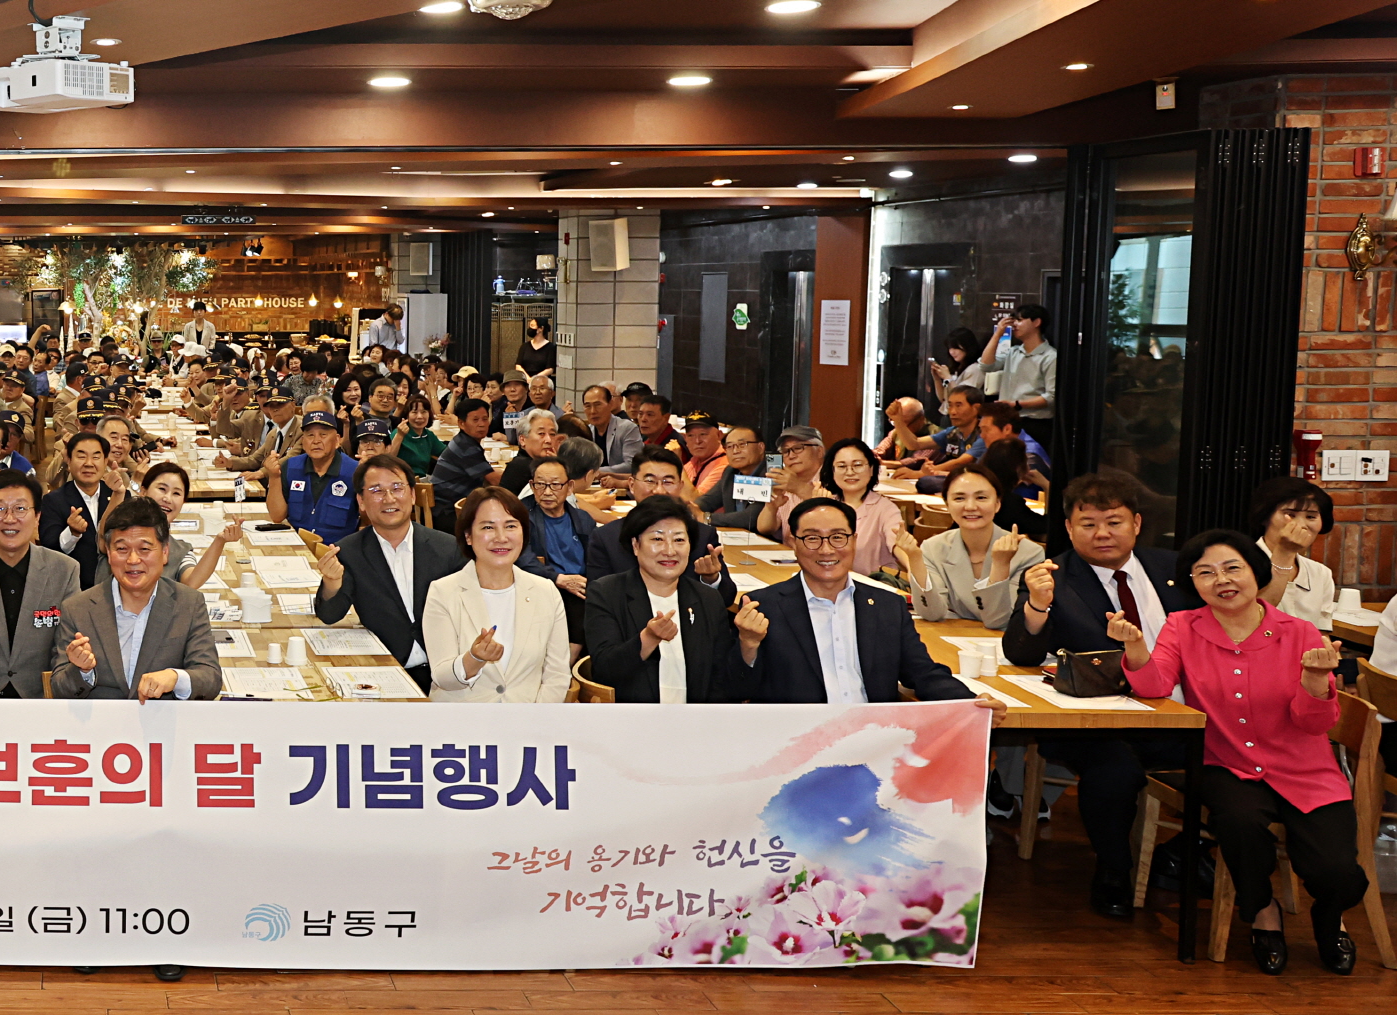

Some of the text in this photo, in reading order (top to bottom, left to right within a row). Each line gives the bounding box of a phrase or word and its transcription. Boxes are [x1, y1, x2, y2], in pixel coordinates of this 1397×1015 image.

[167, 298, 183, 308] DE
[264, 297, 305, 308] HOUSE
[194, 743, 262, 808] 달
[288, 743, 577, 811] 기념행사
[486, 835, 797, 874] 그날의 용기와 헌신을
[539, 882, 725, 921] 기억합니다
[27, 905, 87, 934] (금)
[99, 907, 191, 935] 11:00
[242, 931, 261, 939] 남동구
[303, 909, 418, 938] 남동구
